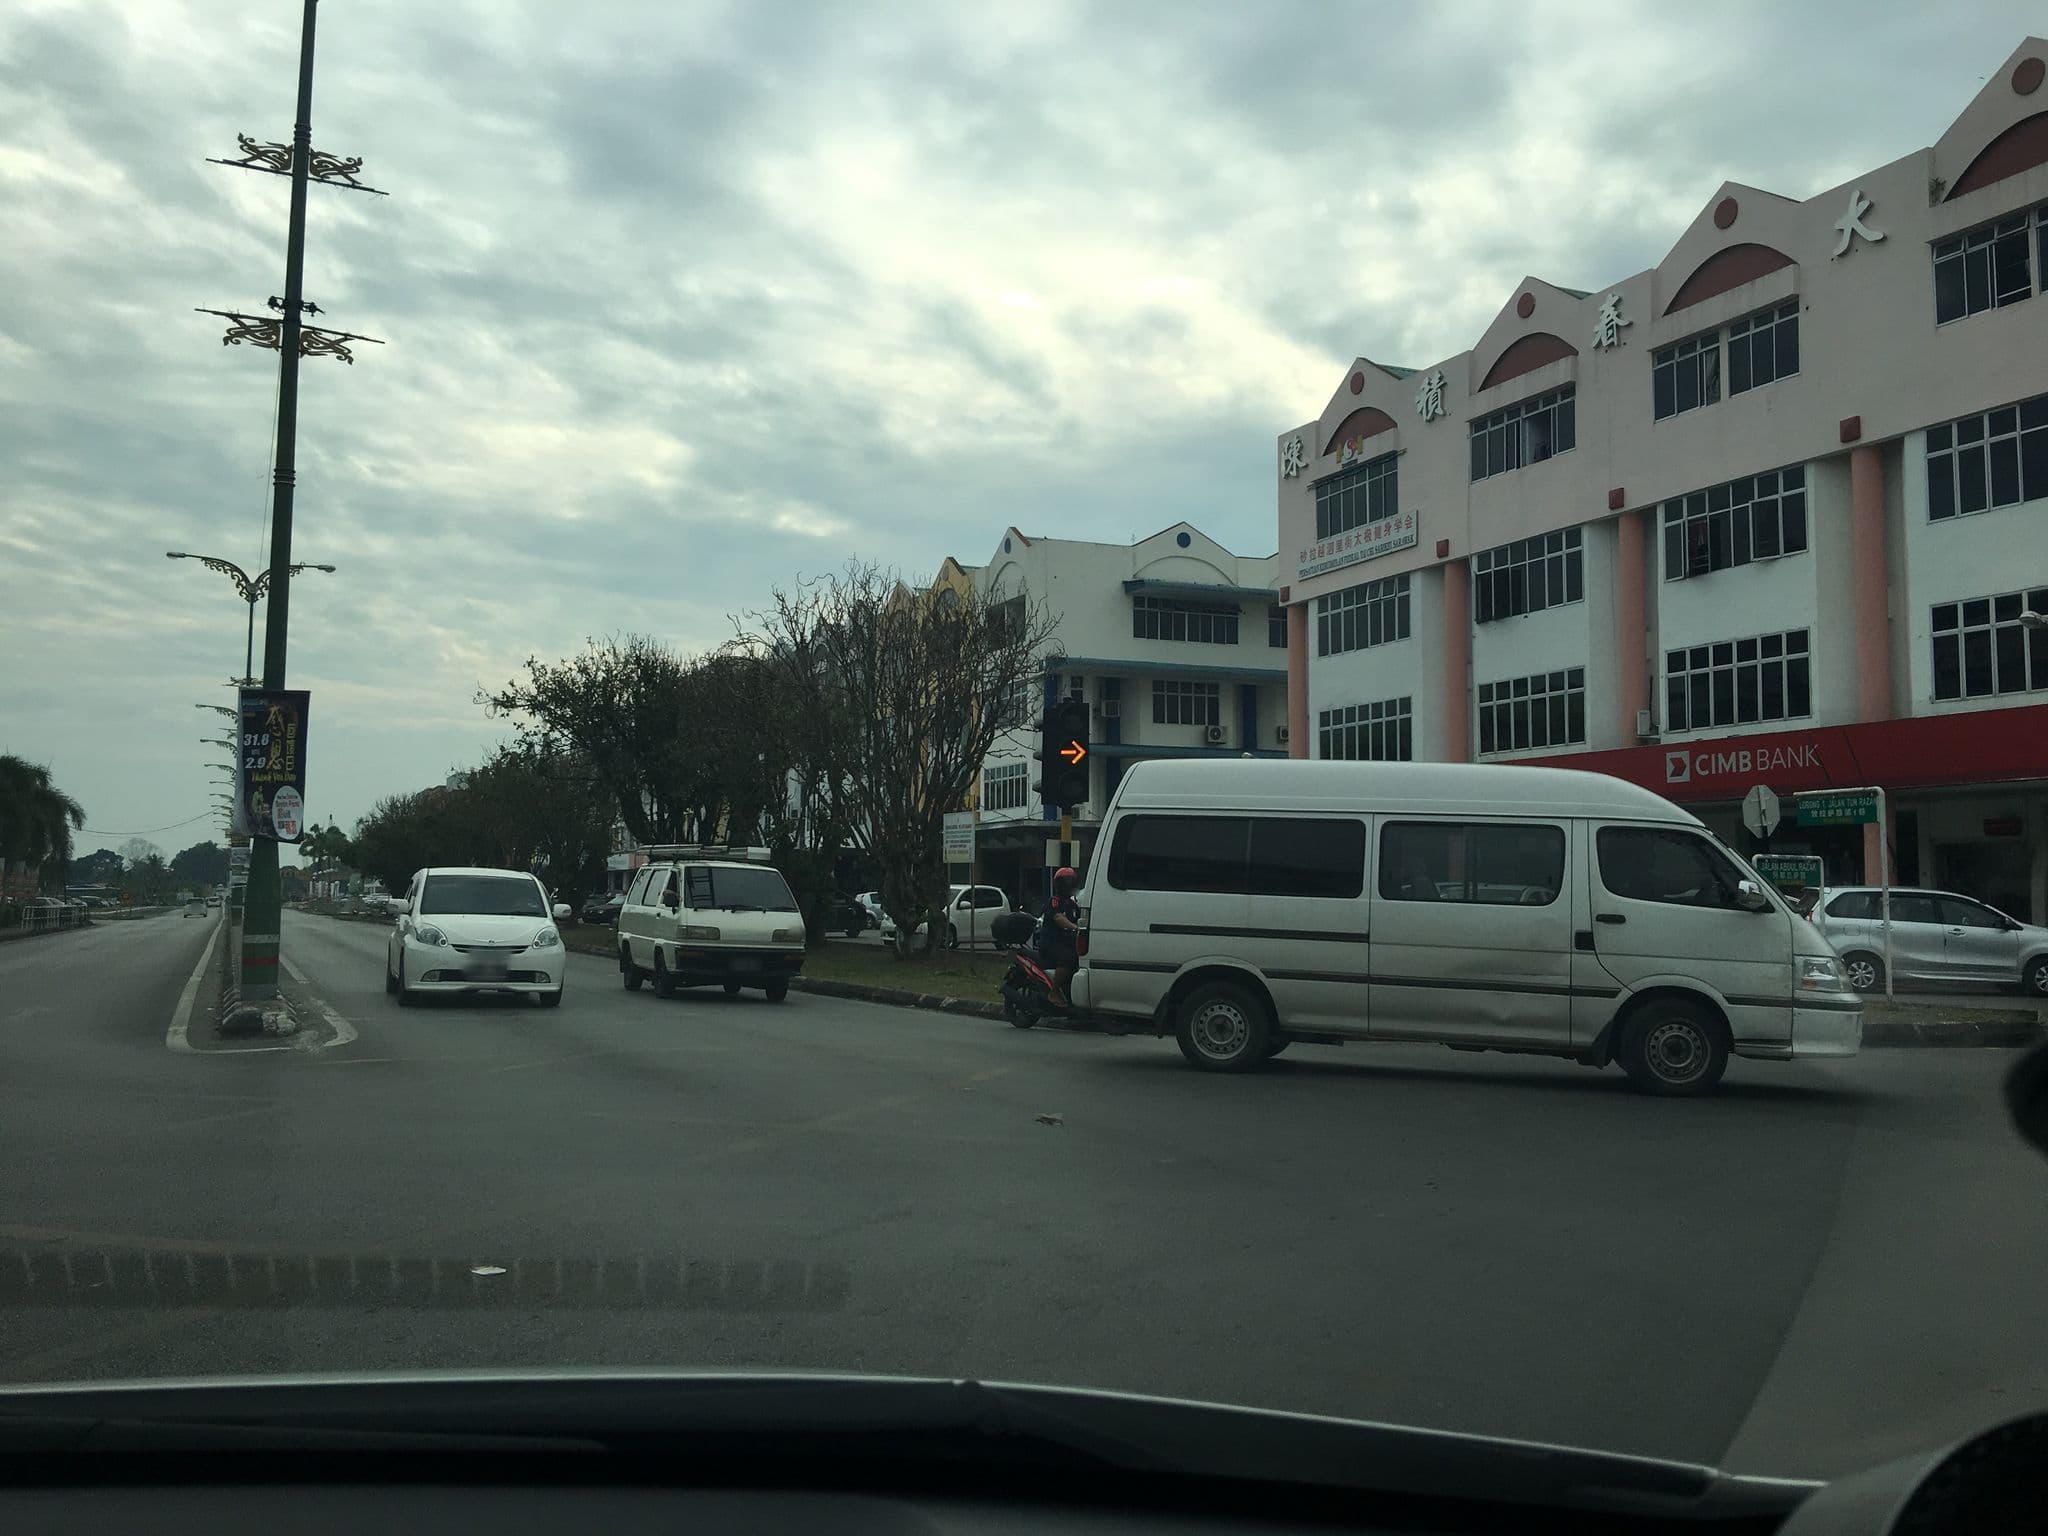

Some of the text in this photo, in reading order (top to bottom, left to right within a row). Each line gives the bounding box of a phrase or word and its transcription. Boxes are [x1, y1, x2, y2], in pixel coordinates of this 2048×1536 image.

[243, 733, 270, 746] 31.8
[245, 756, 266, 769] 2.9
[1695, 744, 1821, 776] CIMB BANK
[1828, 798, 1845, 808] JALAN
[1847, 797, 1857, 807] TUN
[1761, 862, 1816, 872] JALAN ABDUL RAZAK
